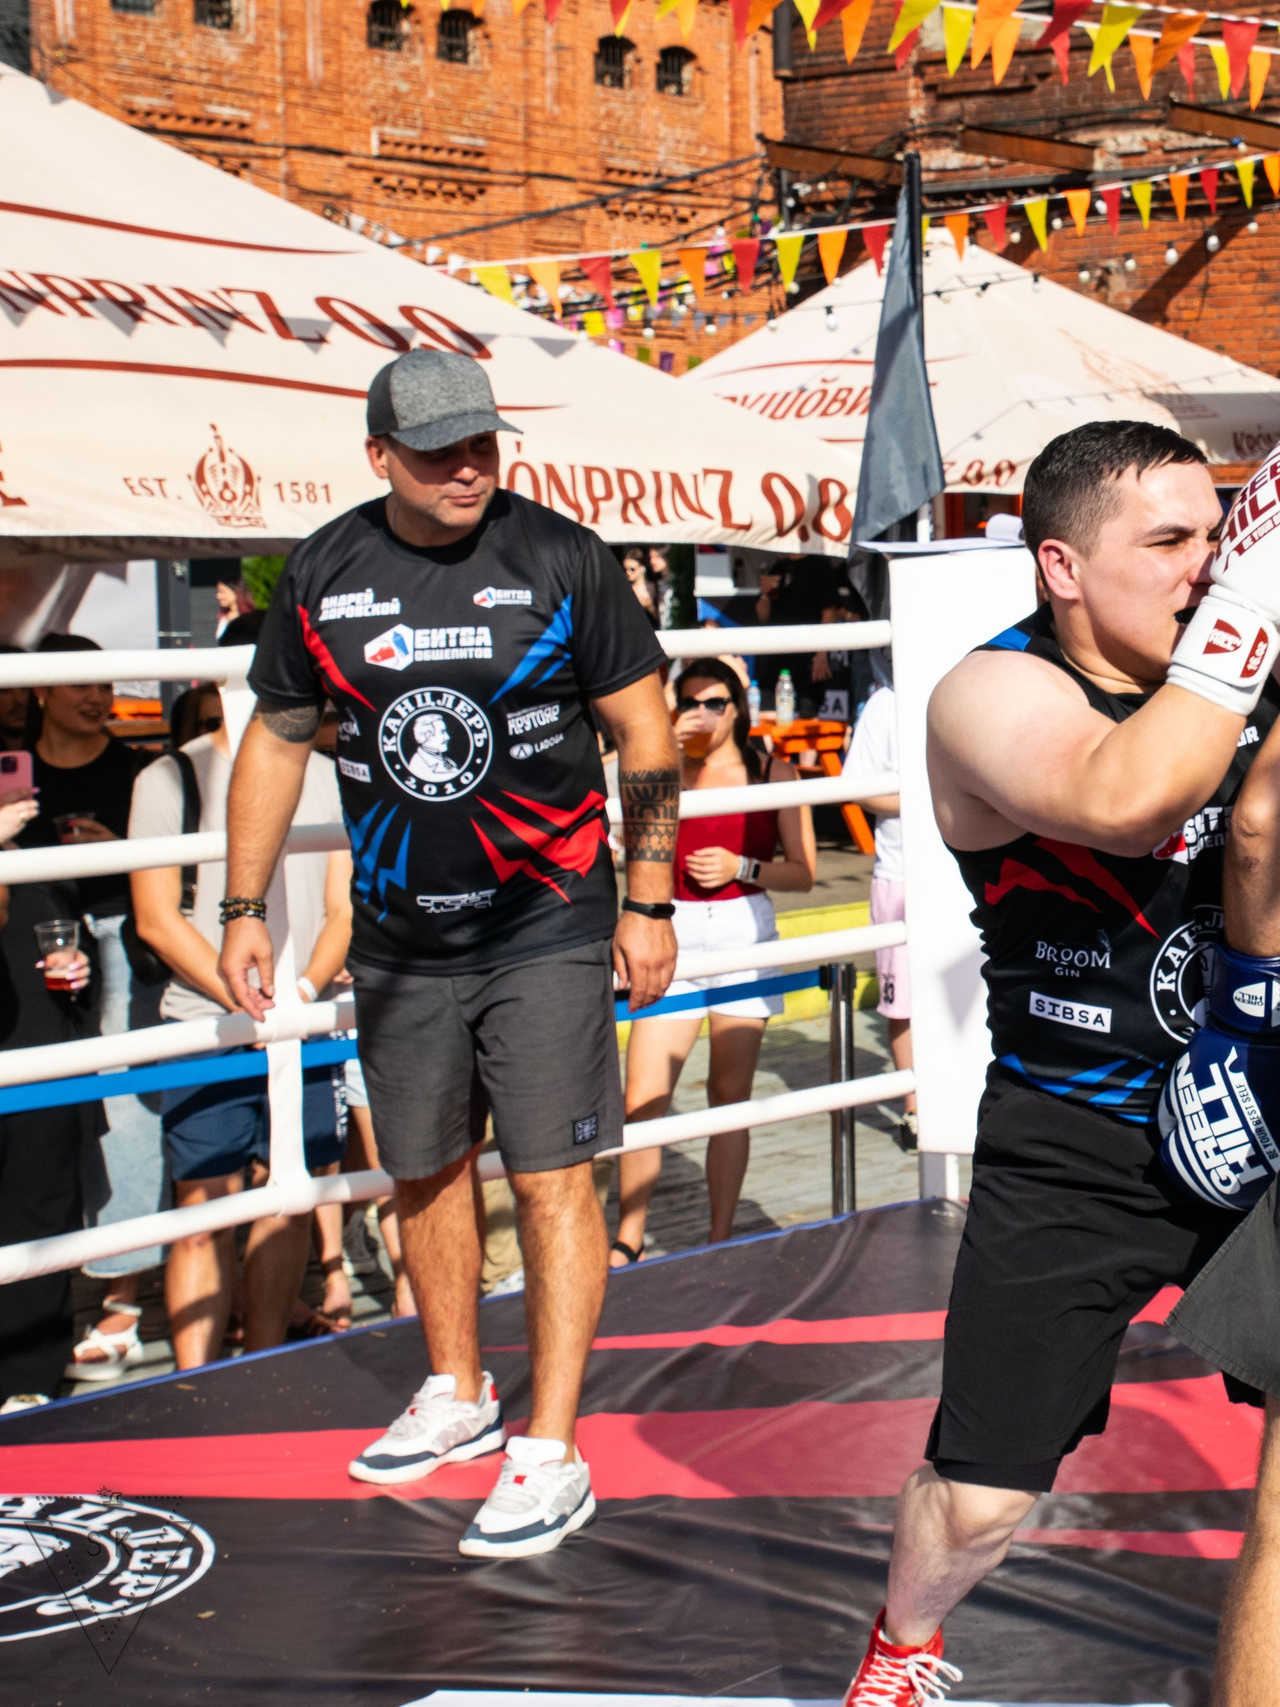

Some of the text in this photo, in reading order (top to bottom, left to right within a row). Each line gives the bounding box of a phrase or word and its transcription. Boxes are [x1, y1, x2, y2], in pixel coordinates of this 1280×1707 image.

[123, 477, 332, 505] EST. 1581
[320, 588, 374, 610] АНДРЕЙ
[414, 626, 493, 649] БИТВА
[382, 691, 488, 752] КАНЦЛЕРЪ
[507, 704, 560, 736] КРУТОЯР
[405, 771, 474, 795] 2010
[1035, 940, 1112, 969] BROOM
[1054, 966, 1080, 978] GIN
[1035, 998, 1106, 1027] SIBSA
[1177, 1052, 1241, 1194] GREEN
[1198, 1063, 1269, 1185] HILL
[1236, 1083, 1279, 1160] BE YOUR BEST SELF
